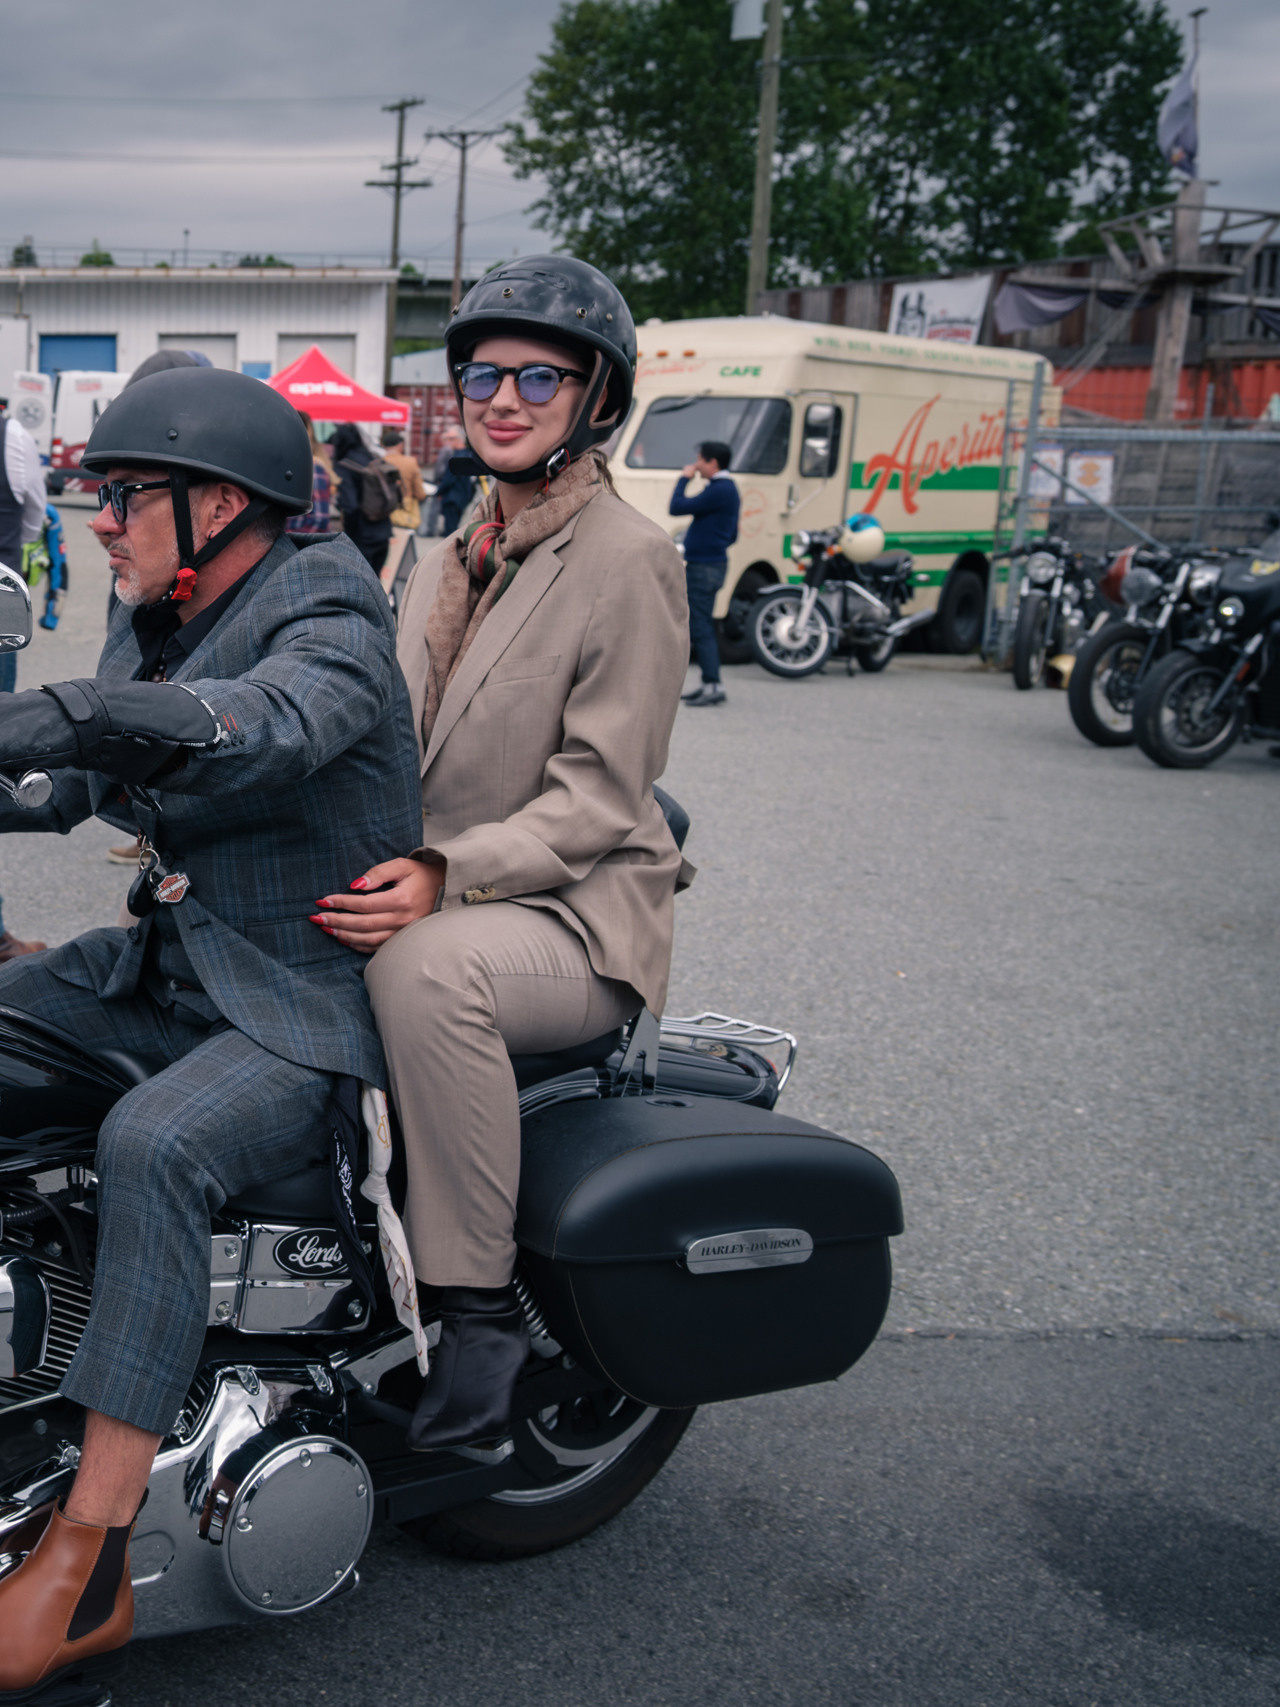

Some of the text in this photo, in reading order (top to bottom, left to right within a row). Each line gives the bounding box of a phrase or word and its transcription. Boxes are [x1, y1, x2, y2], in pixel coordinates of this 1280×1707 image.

[719, 365, 763, 378] CAFE
[862, 393, 1032, 516] Aperiti
[288, 1235, 343, 1268] Lords
[700, 1237, 802, 1257] HARLEY-DAVIDSON
